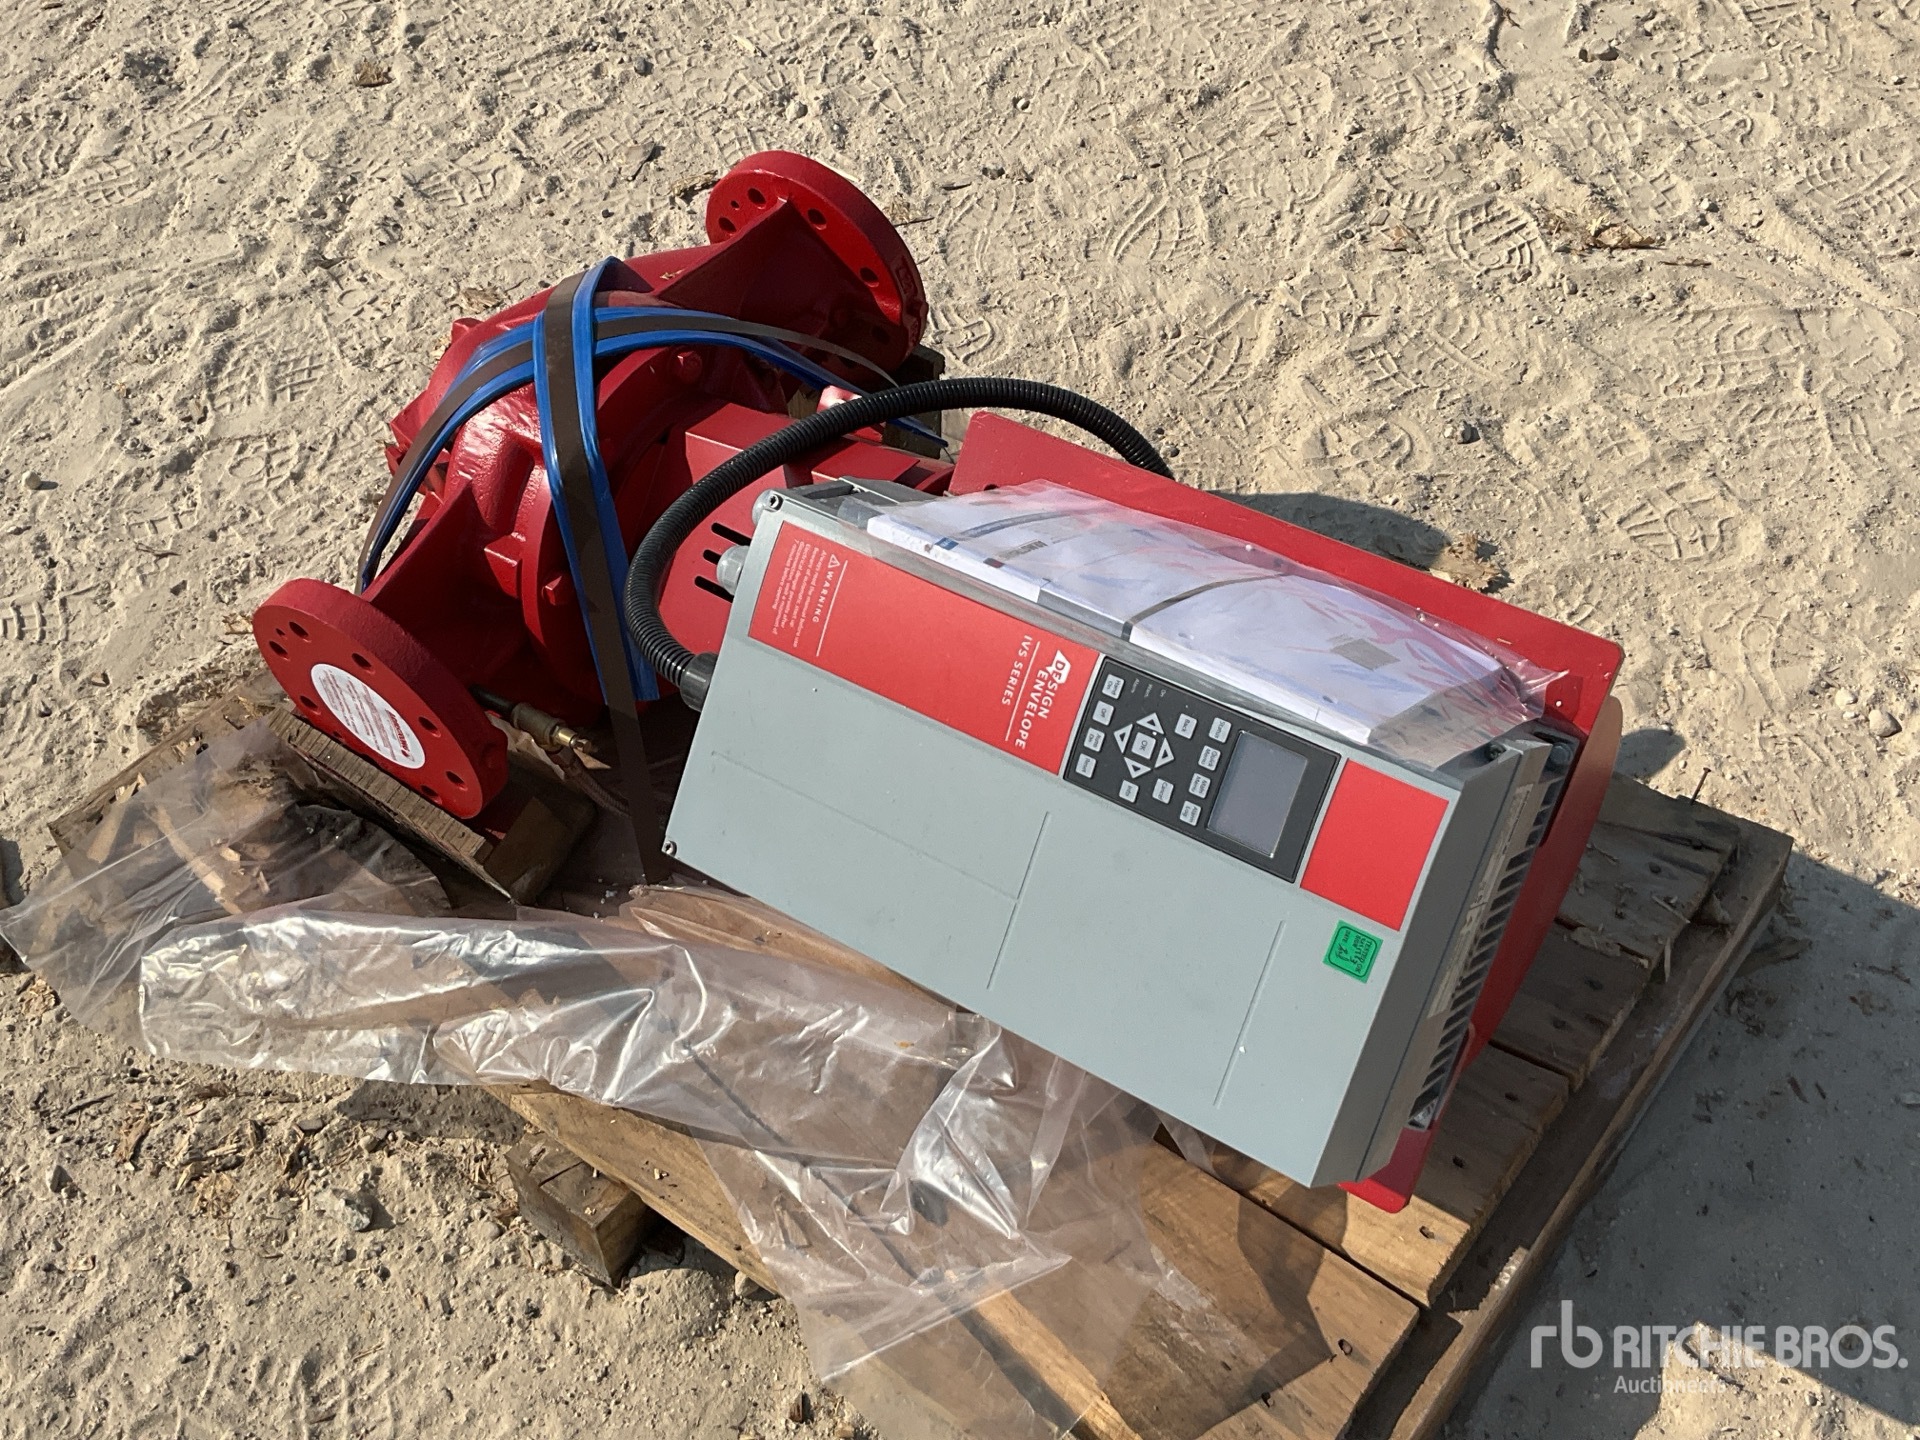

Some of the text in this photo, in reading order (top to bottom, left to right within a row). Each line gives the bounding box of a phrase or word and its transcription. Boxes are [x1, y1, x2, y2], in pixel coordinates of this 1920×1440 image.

[785, 543, 796, 567] minutes
[797, 543, 810, 570] Electrical
[808, 547, 819, 568] Beware
[814, 549, 827, 572] Always
[779, 567, 789, 585] before
[790, 569, 801, 590] danger
[805, 568, 811, 576] of
[810, 571, 819, 585] read
[771, 585, 782, 609] opening
[807, 585, 815, 595] the
[811, 570, 834, 622] WARNING
[800, 596, 811, 617] manual
[779, 613, 789, 628] after
[795, 617, 805, 636] before
[1001, 634, 1032, 706] IVS SERIES
[1037, 659, 1065, 719] DESIGN
[1105, 680, 1112, 690] On
[1110, 679, 1120, 695] Hand
[1130, 679, 1139, 693] Alarm
[1159, 688, 1166, 698] On
[1013, 669, 1048, 749] ENVELOPE
[1099, 708, 1107, 717] Off
[1180, 718, 1190, 732] Back
[1214, 720, 1225, 739] Status
[1087, 733, 1094, 742] On
[1092, 733, 1101, 747] Auto
[1139, 740, 1147, 750] OK
[1200, 748, 1210, 765] Menu
[1207, 750, 1217, 767] Quick
[1081, 758, 1090, 773] Reset
[1124, 785, 1133, 796] Info
[1157, 781, 1168, 800] Cancel
[1191, 775, 1200, 792] Menu
[1198, 779, 1207, 794] Main
[1181, 805, 1190, 817] Log
[1189, 806, 1198, 822] Alarm
